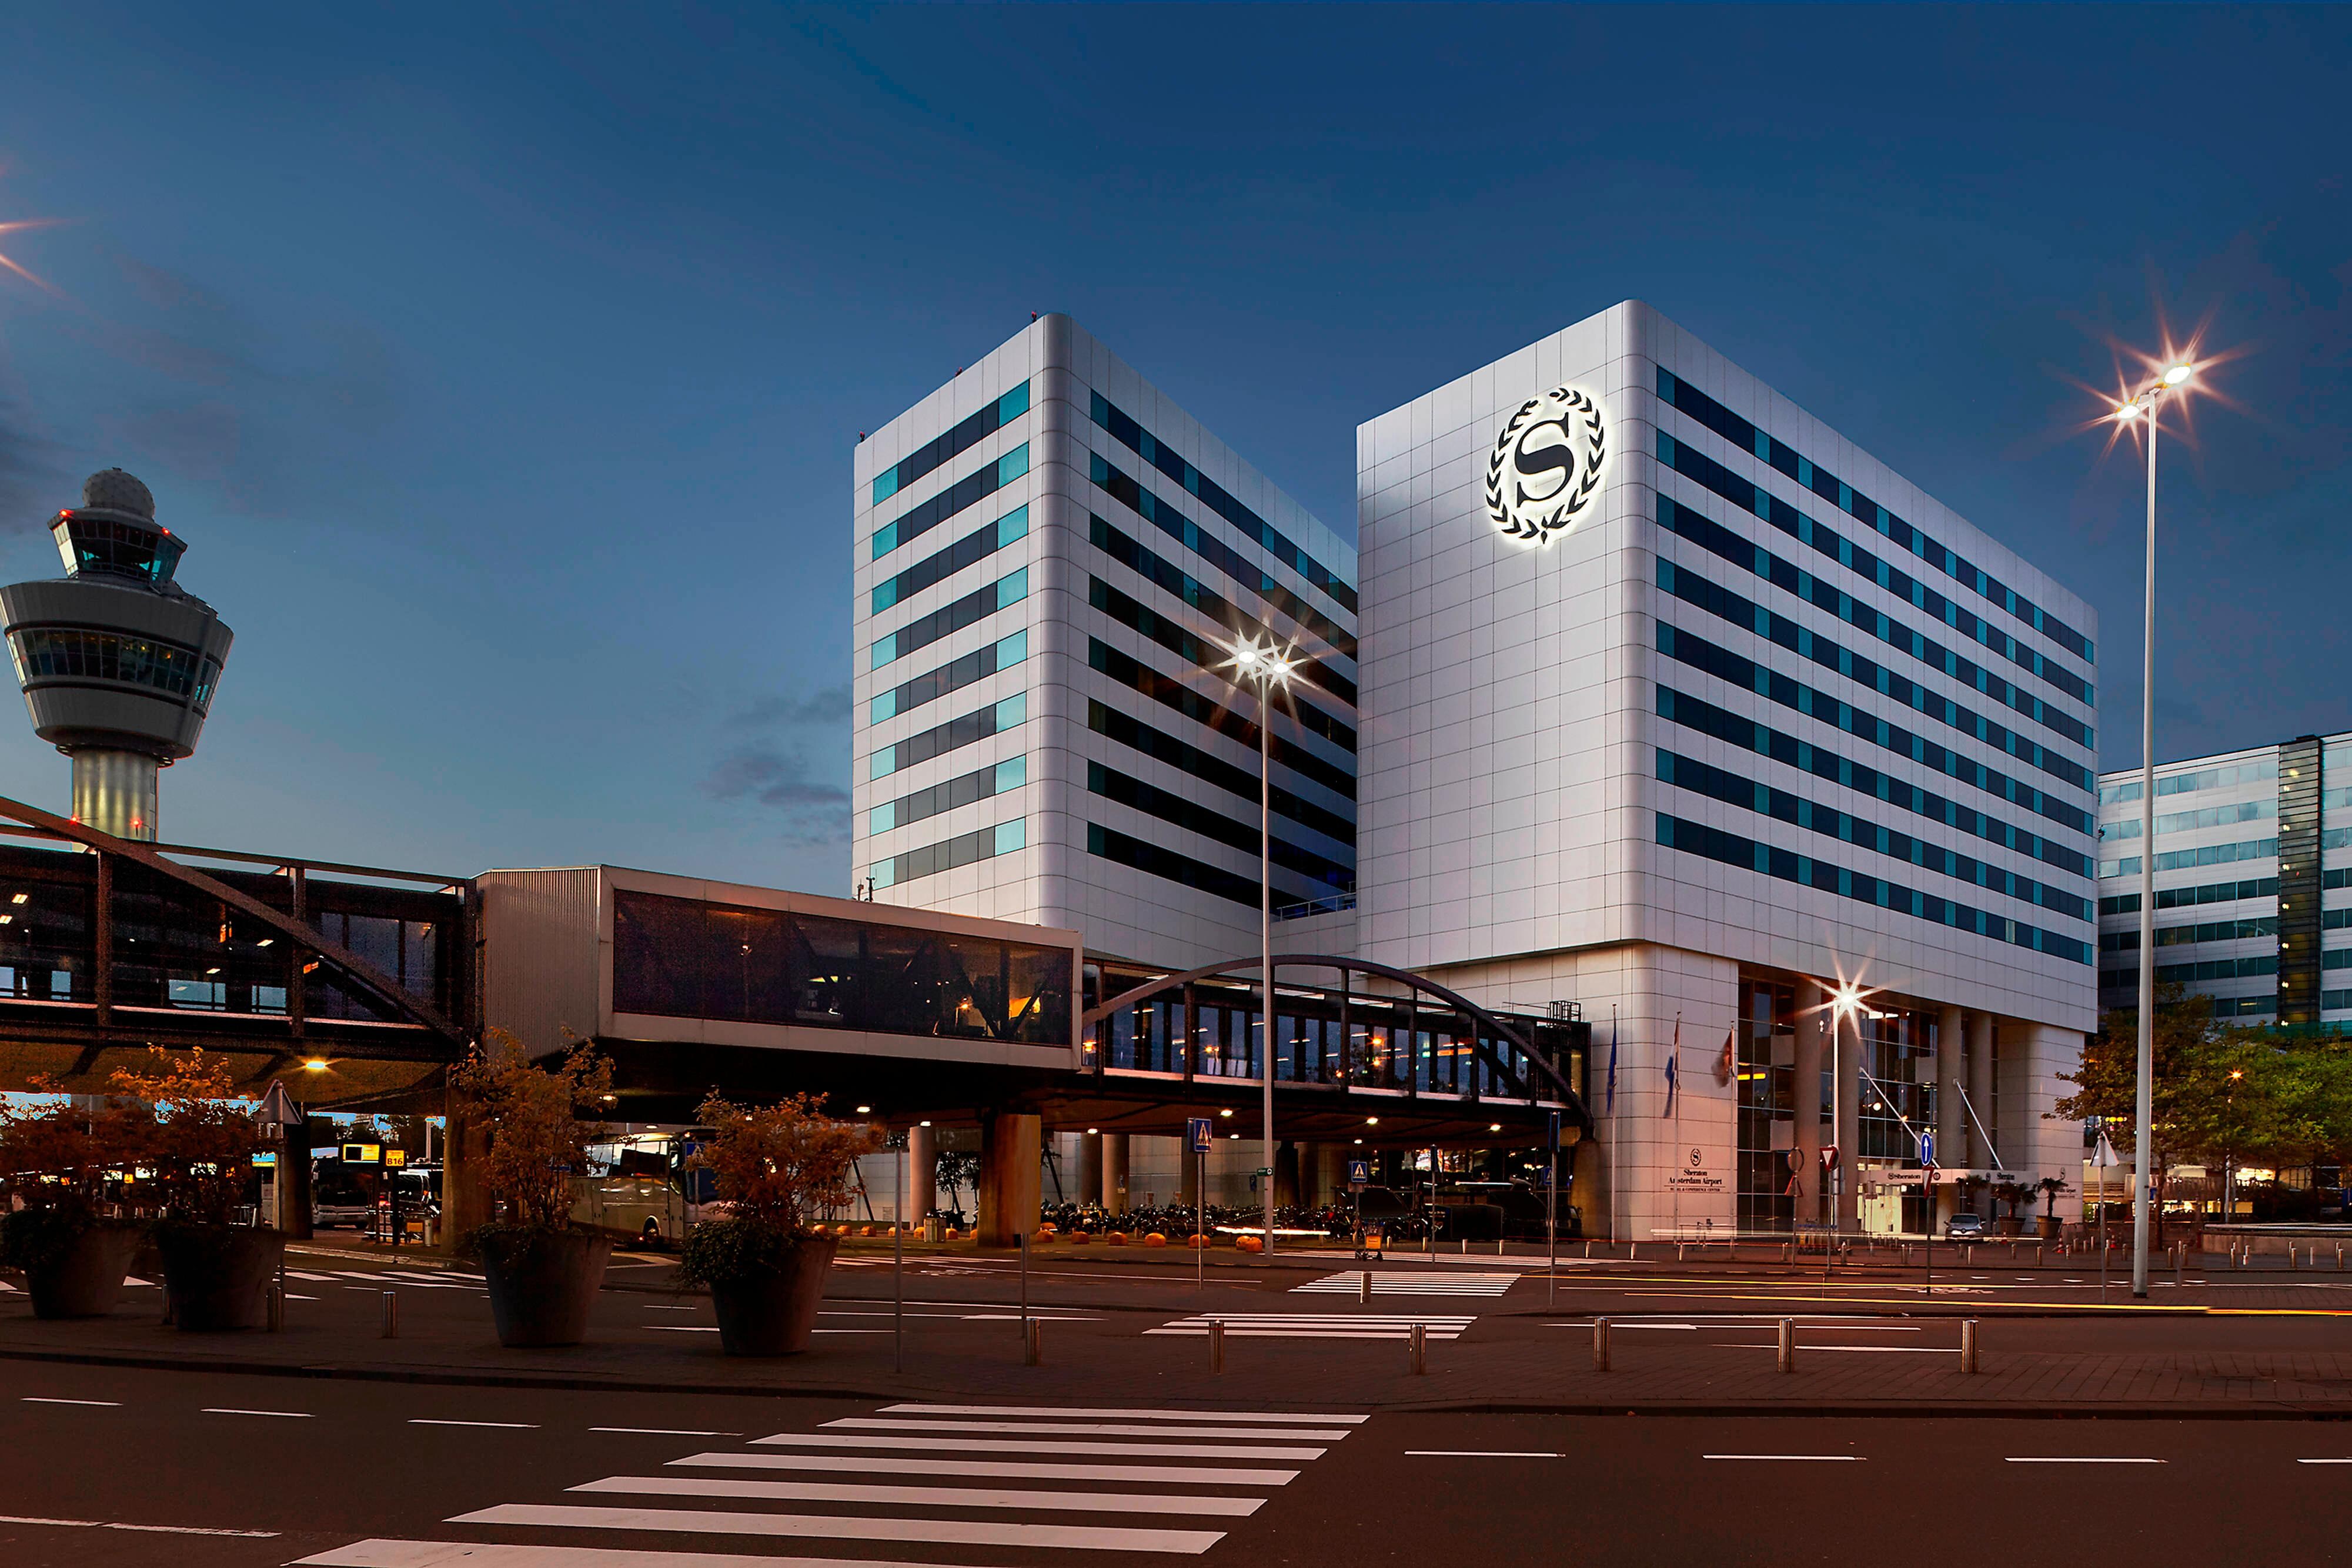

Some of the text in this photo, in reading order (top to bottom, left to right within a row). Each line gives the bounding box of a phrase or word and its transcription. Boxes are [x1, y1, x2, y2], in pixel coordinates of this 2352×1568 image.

[1514, 412, 1575, 509] S
[1693, 1151, 1699, 1162] S
[1702, 1177, 1722, 1187] Airport
